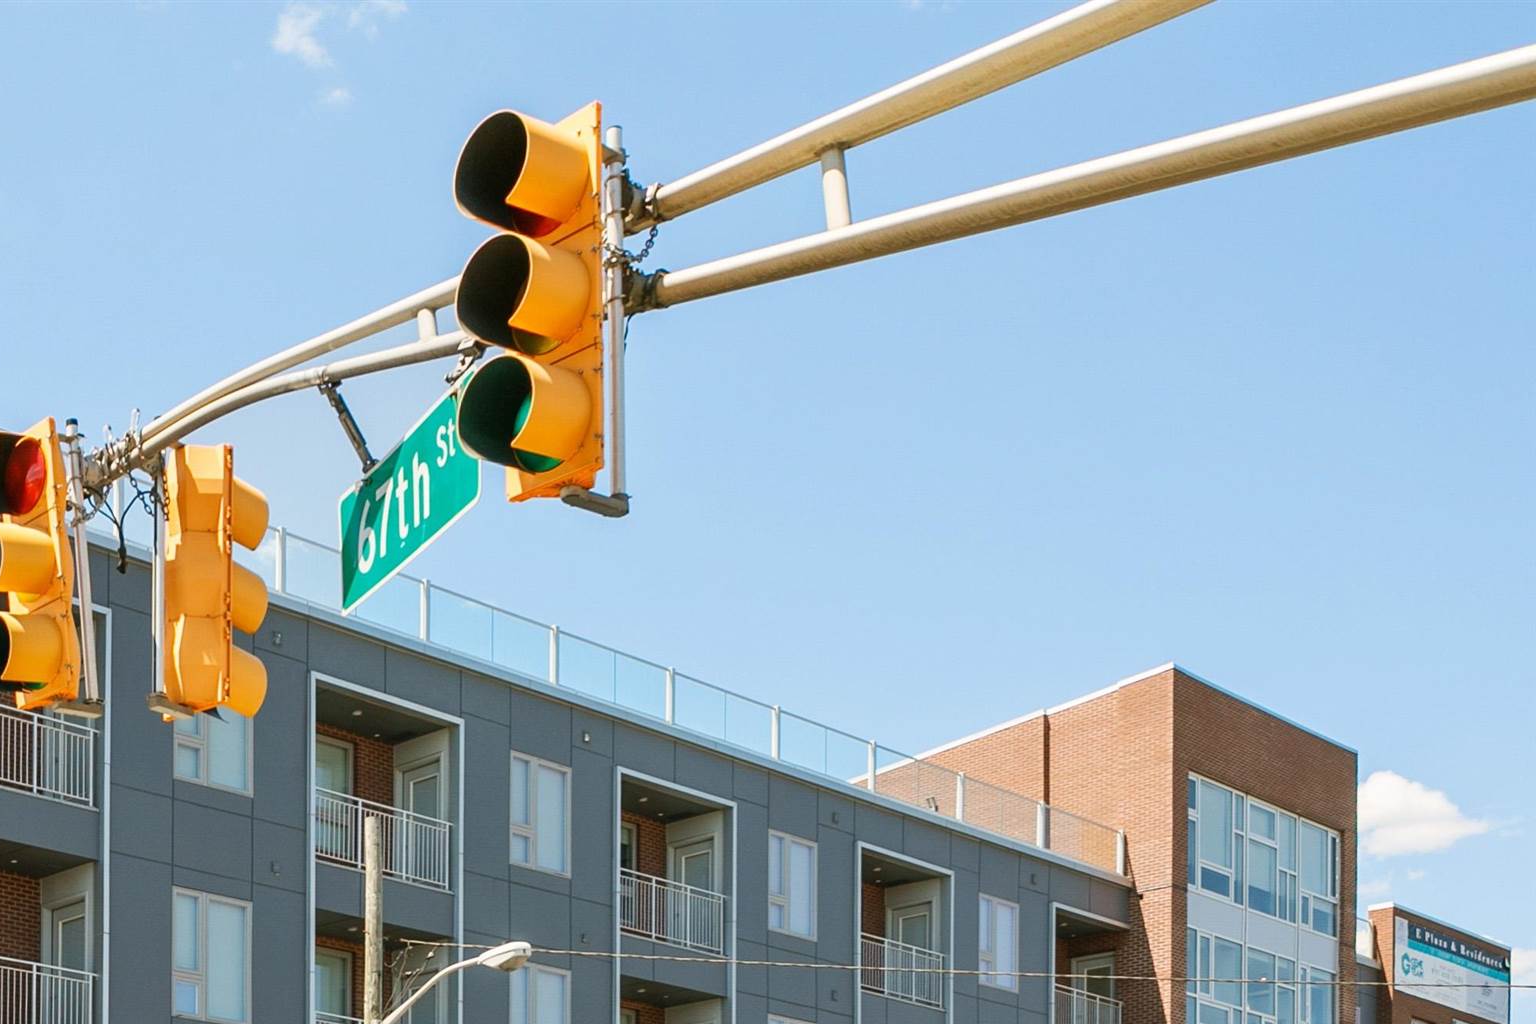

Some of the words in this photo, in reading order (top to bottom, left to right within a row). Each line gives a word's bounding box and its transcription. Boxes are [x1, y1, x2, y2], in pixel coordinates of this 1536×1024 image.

[358, 452, 430, 574] 67th
[436, 418, 456, 468] St
[1425, 931, 1448, 949] Plaza
[1460, 944, 1503, 969] Residences
